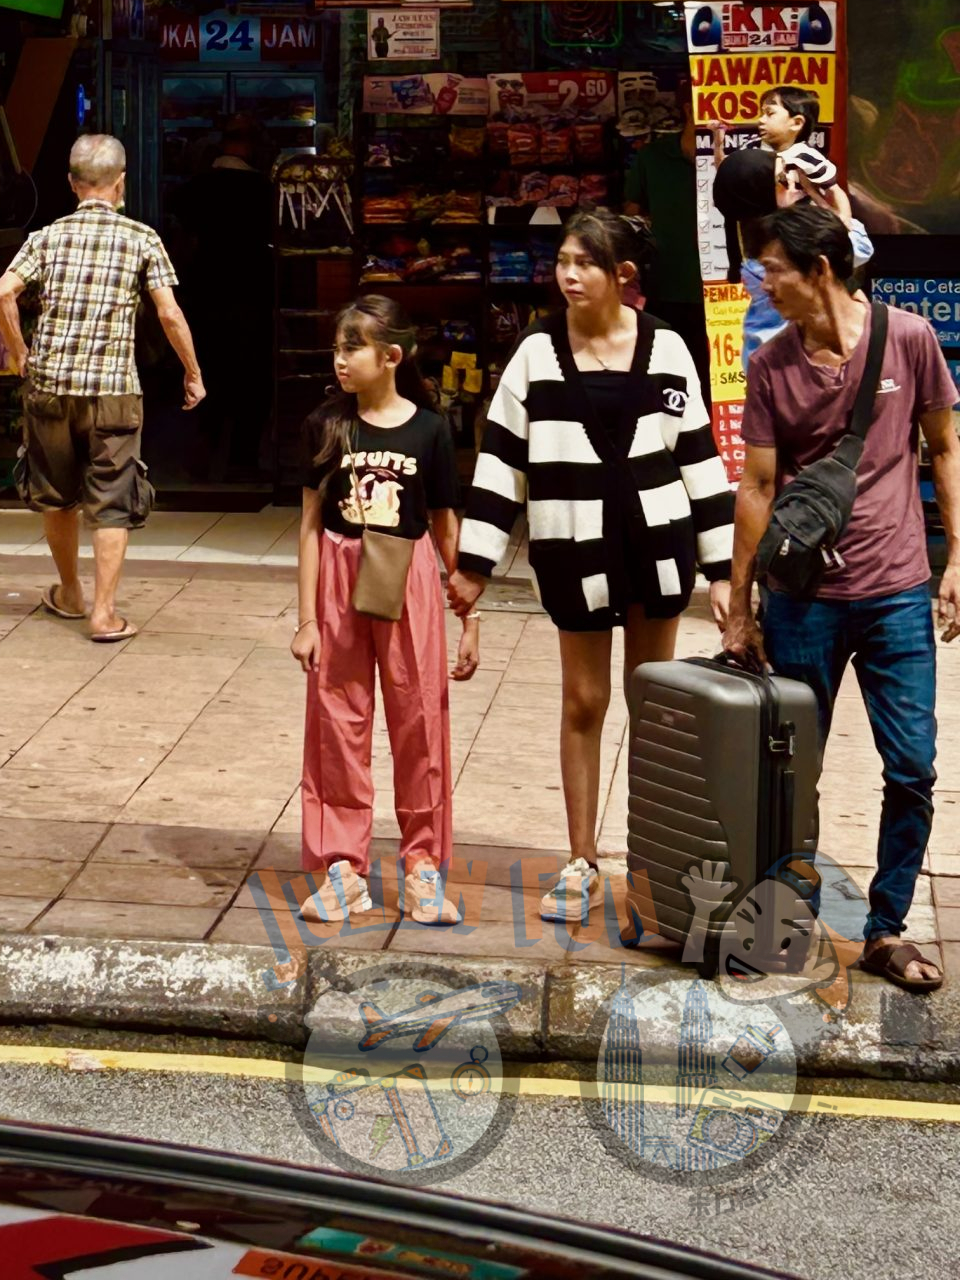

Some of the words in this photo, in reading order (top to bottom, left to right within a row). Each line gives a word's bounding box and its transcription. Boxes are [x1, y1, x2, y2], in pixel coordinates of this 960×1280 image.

[206, 19, 254, 51] 24
[263, 23, 316, 48] JAM
[750, 34, 772, 46] 24
[692, 56, 829, 87] JAWATAN
[871, 278, 920, 294] Kedai
[924, 278, 960, 294] Ceta
